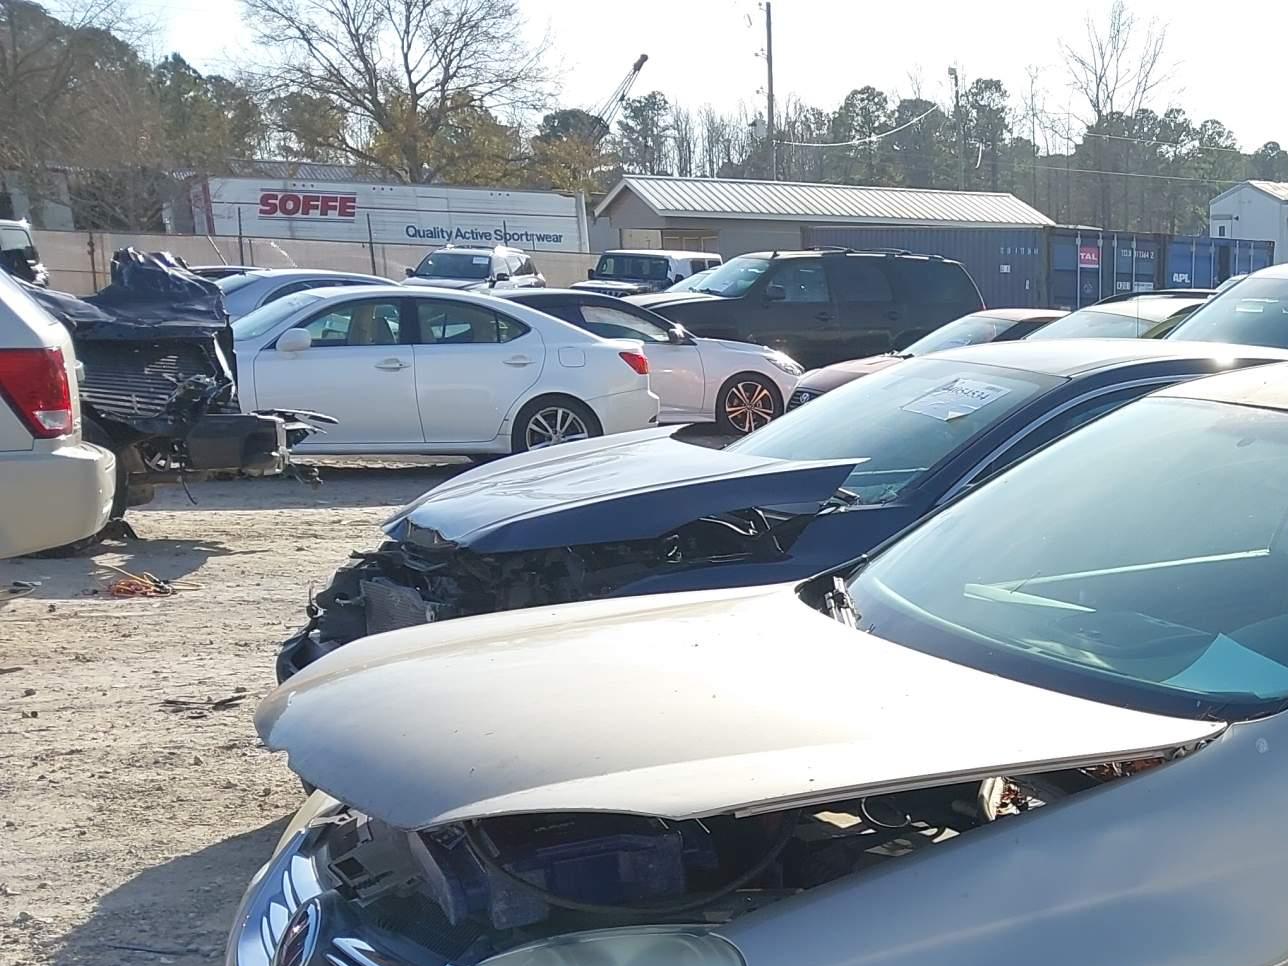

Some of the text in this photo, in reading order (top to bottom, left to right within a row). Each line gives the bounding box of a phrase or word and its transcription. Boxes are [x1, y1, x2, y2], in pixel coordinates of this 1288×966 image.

[258, 192, 357, 218] SOFFE
[405, 224, 563, 244] Quality Active Sportwear
[1080, 252, 1098, 261] TAL
[1172, 273, 1190, 283] APL
